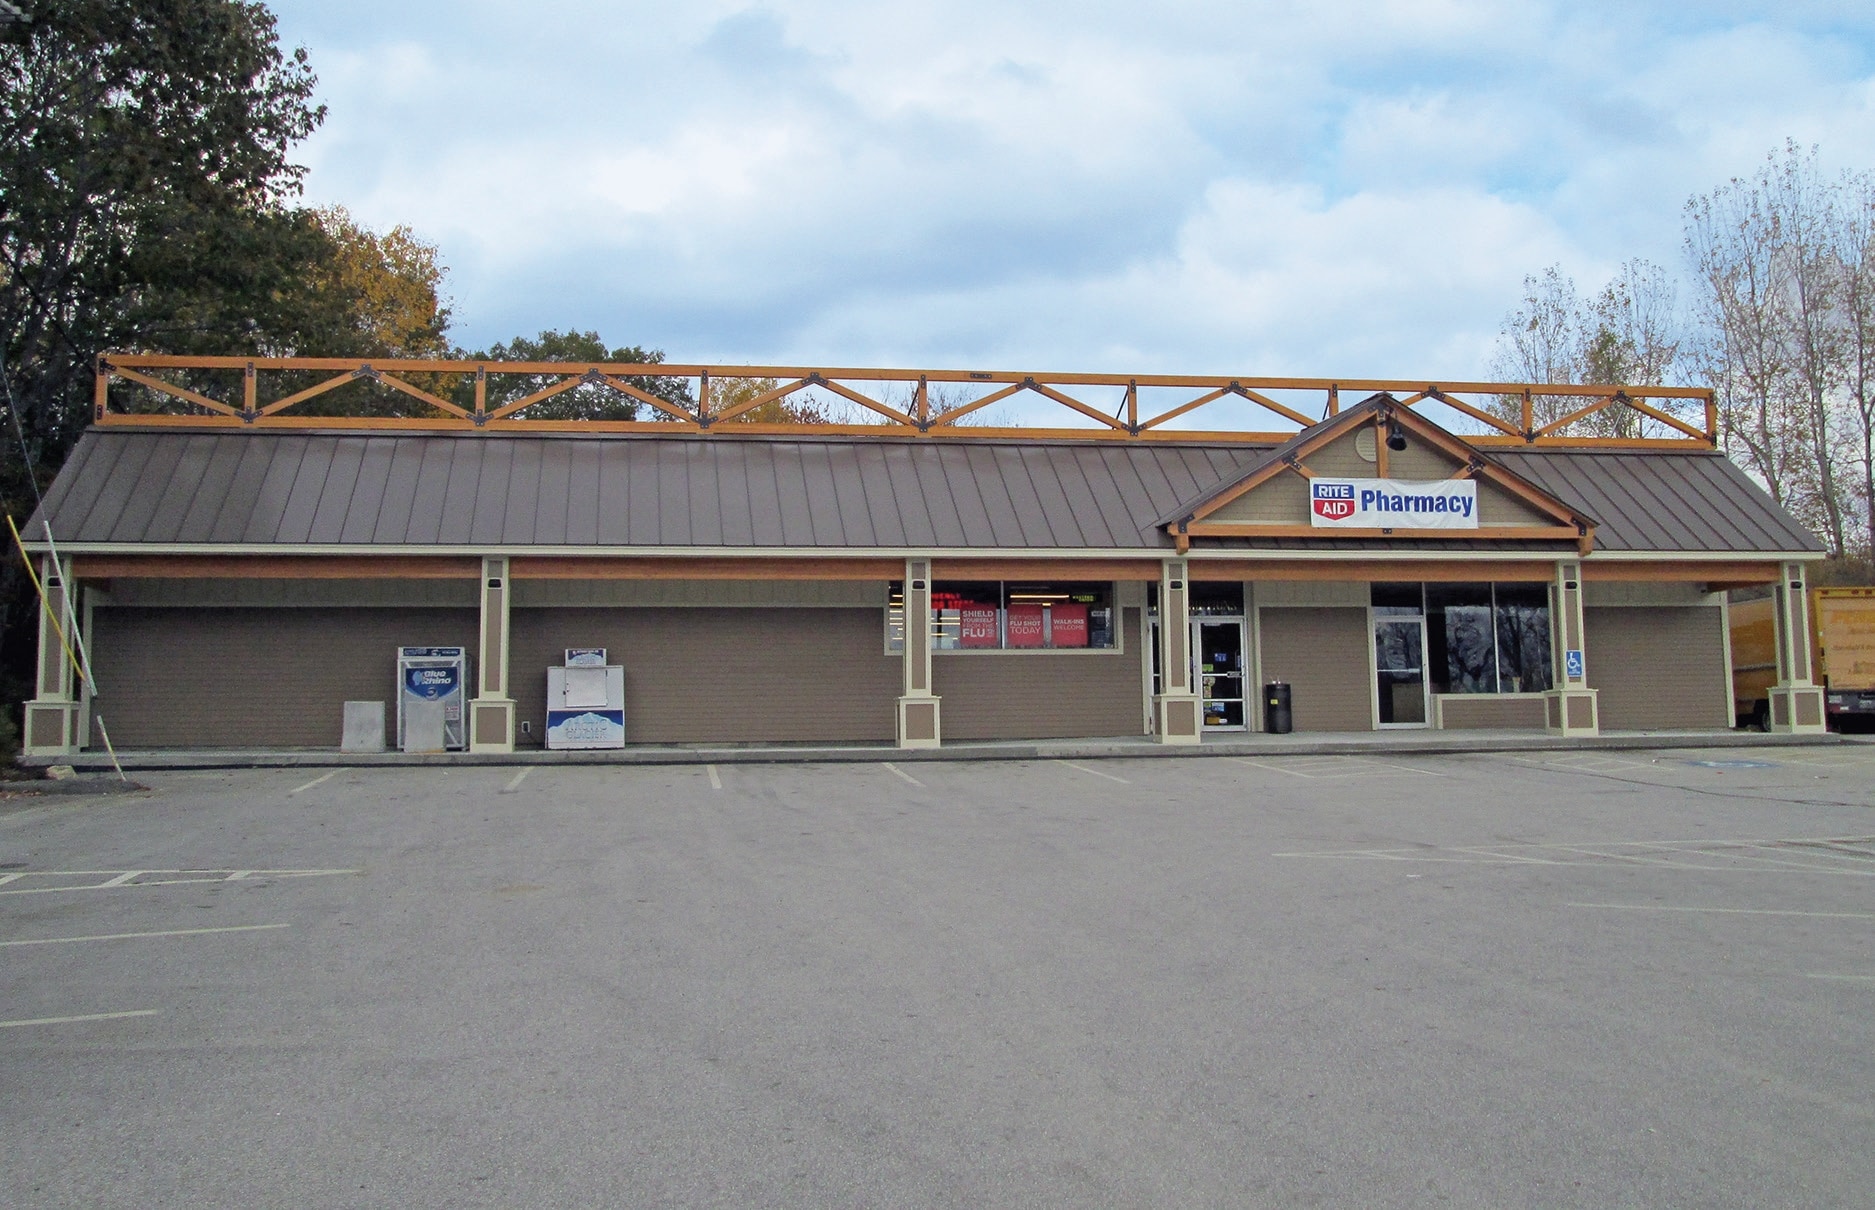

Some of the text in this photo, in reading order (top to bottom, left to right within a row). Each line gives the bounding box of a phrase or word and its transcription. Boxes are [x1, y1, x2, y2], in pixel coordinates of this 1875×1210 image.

[1318, 485, 1350, 498] RITE
[1321, 502, 1348, 515] AID
[1361, 490, 1473, 517] Pharmacy
[962, 628, 986, 638] FLU
[1010, 626, 1041, 634] TODAY
[422, 670, 447, 678] Blue
[421, 677, 452, 685] Rhino
